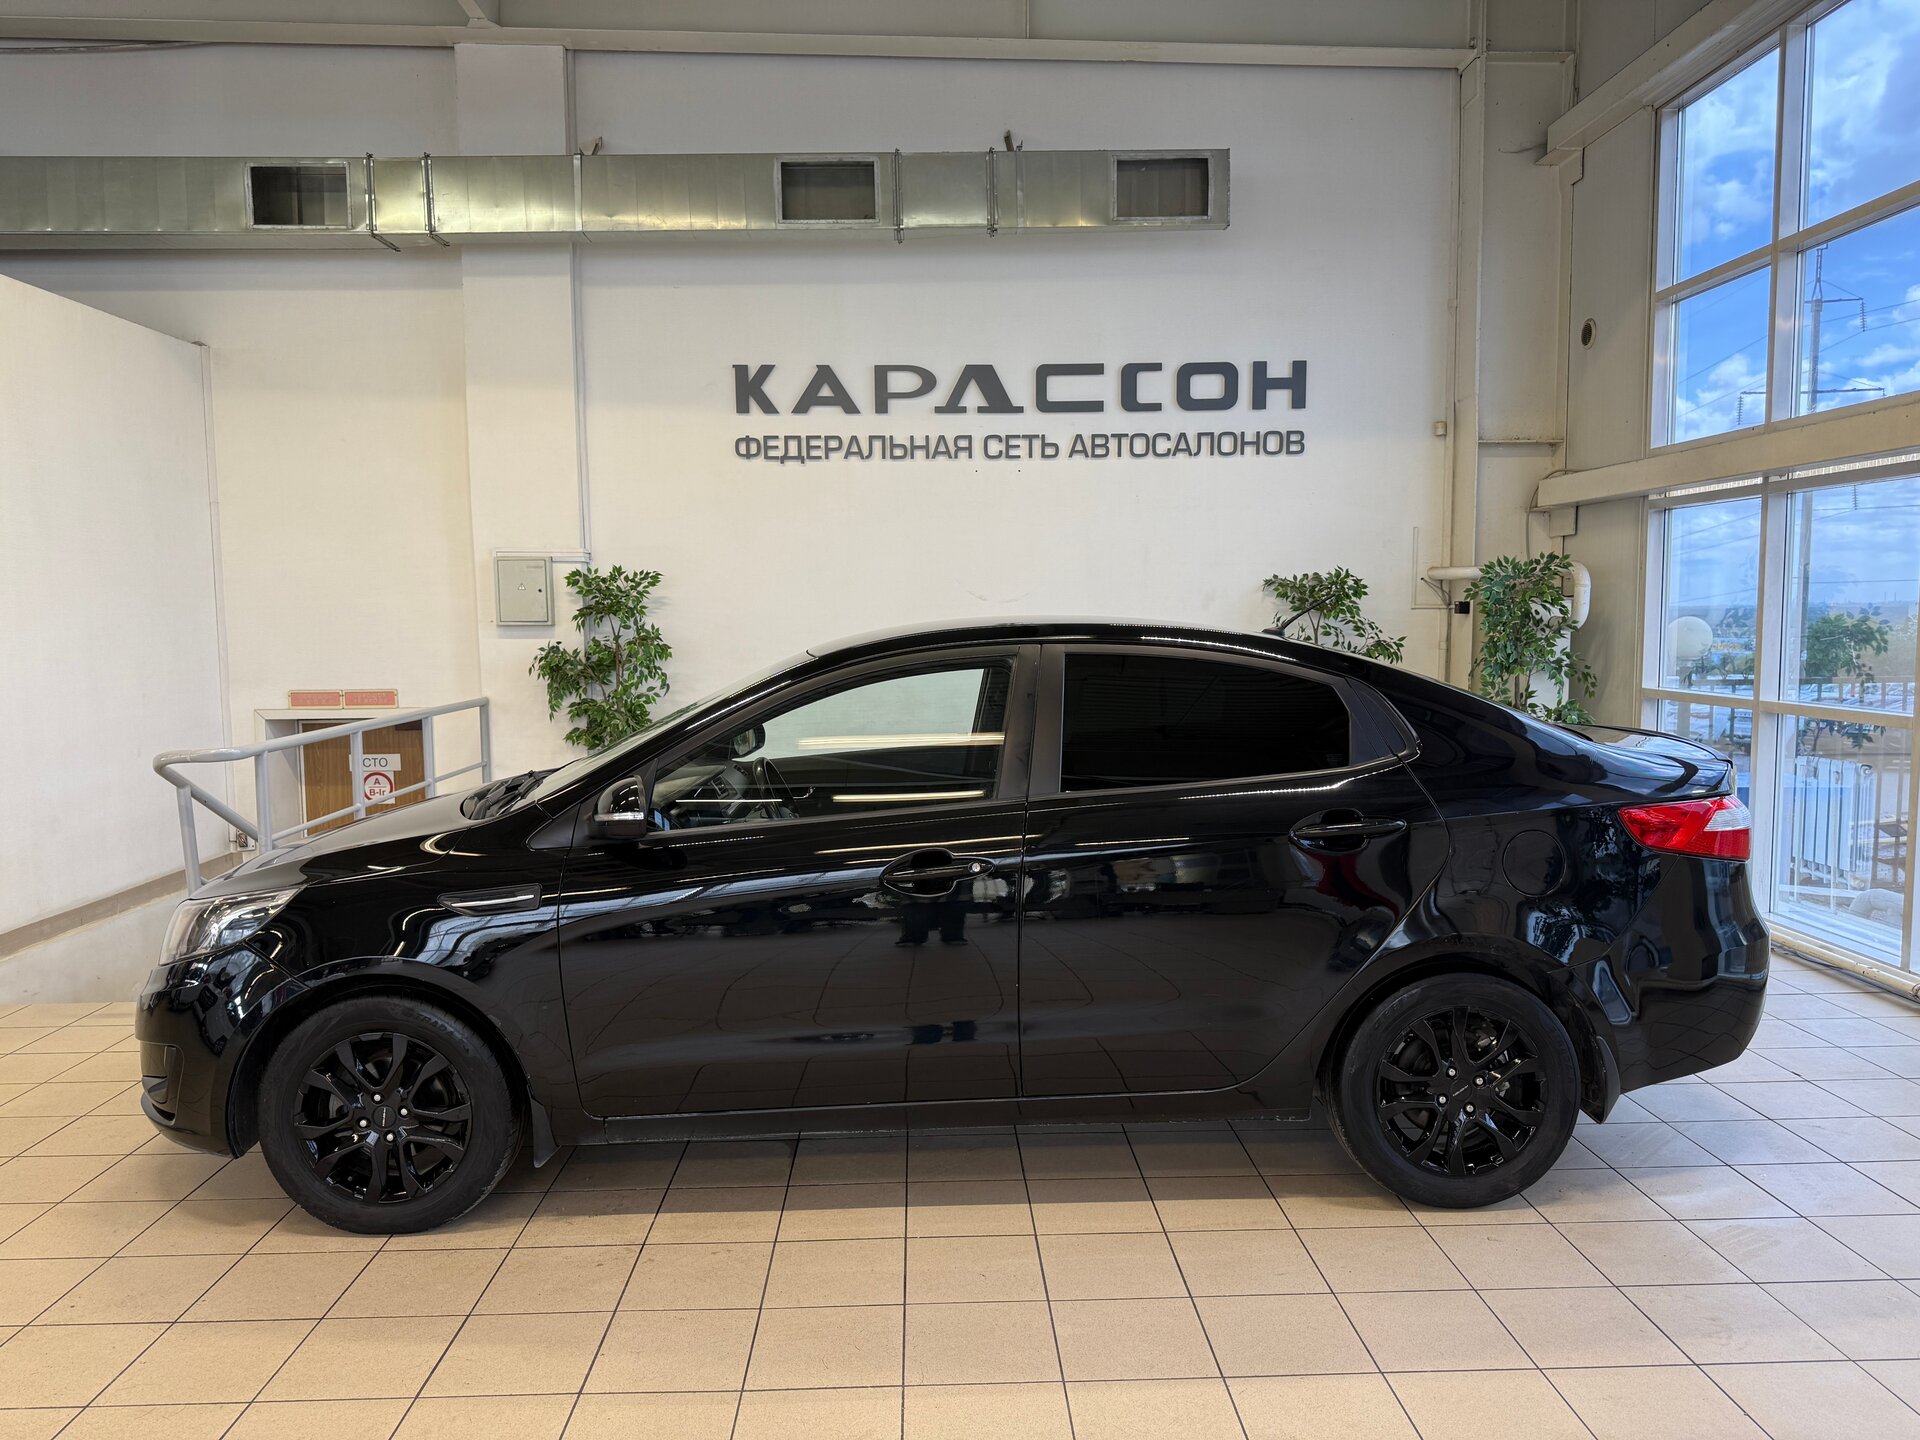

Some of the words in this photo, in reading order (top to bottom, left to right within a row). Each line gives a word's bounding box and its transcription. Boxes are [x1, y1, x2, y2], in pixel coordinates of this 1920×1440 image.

[734, 435, 973, 464] ФЕДЕРАЛЬНАЯ
[983, 433, 1060, 460] СЕТЬ
[1068, 430, 1306, 458] АВТОСАЛОНОВ
[362, 757, 388, 768] СТО
